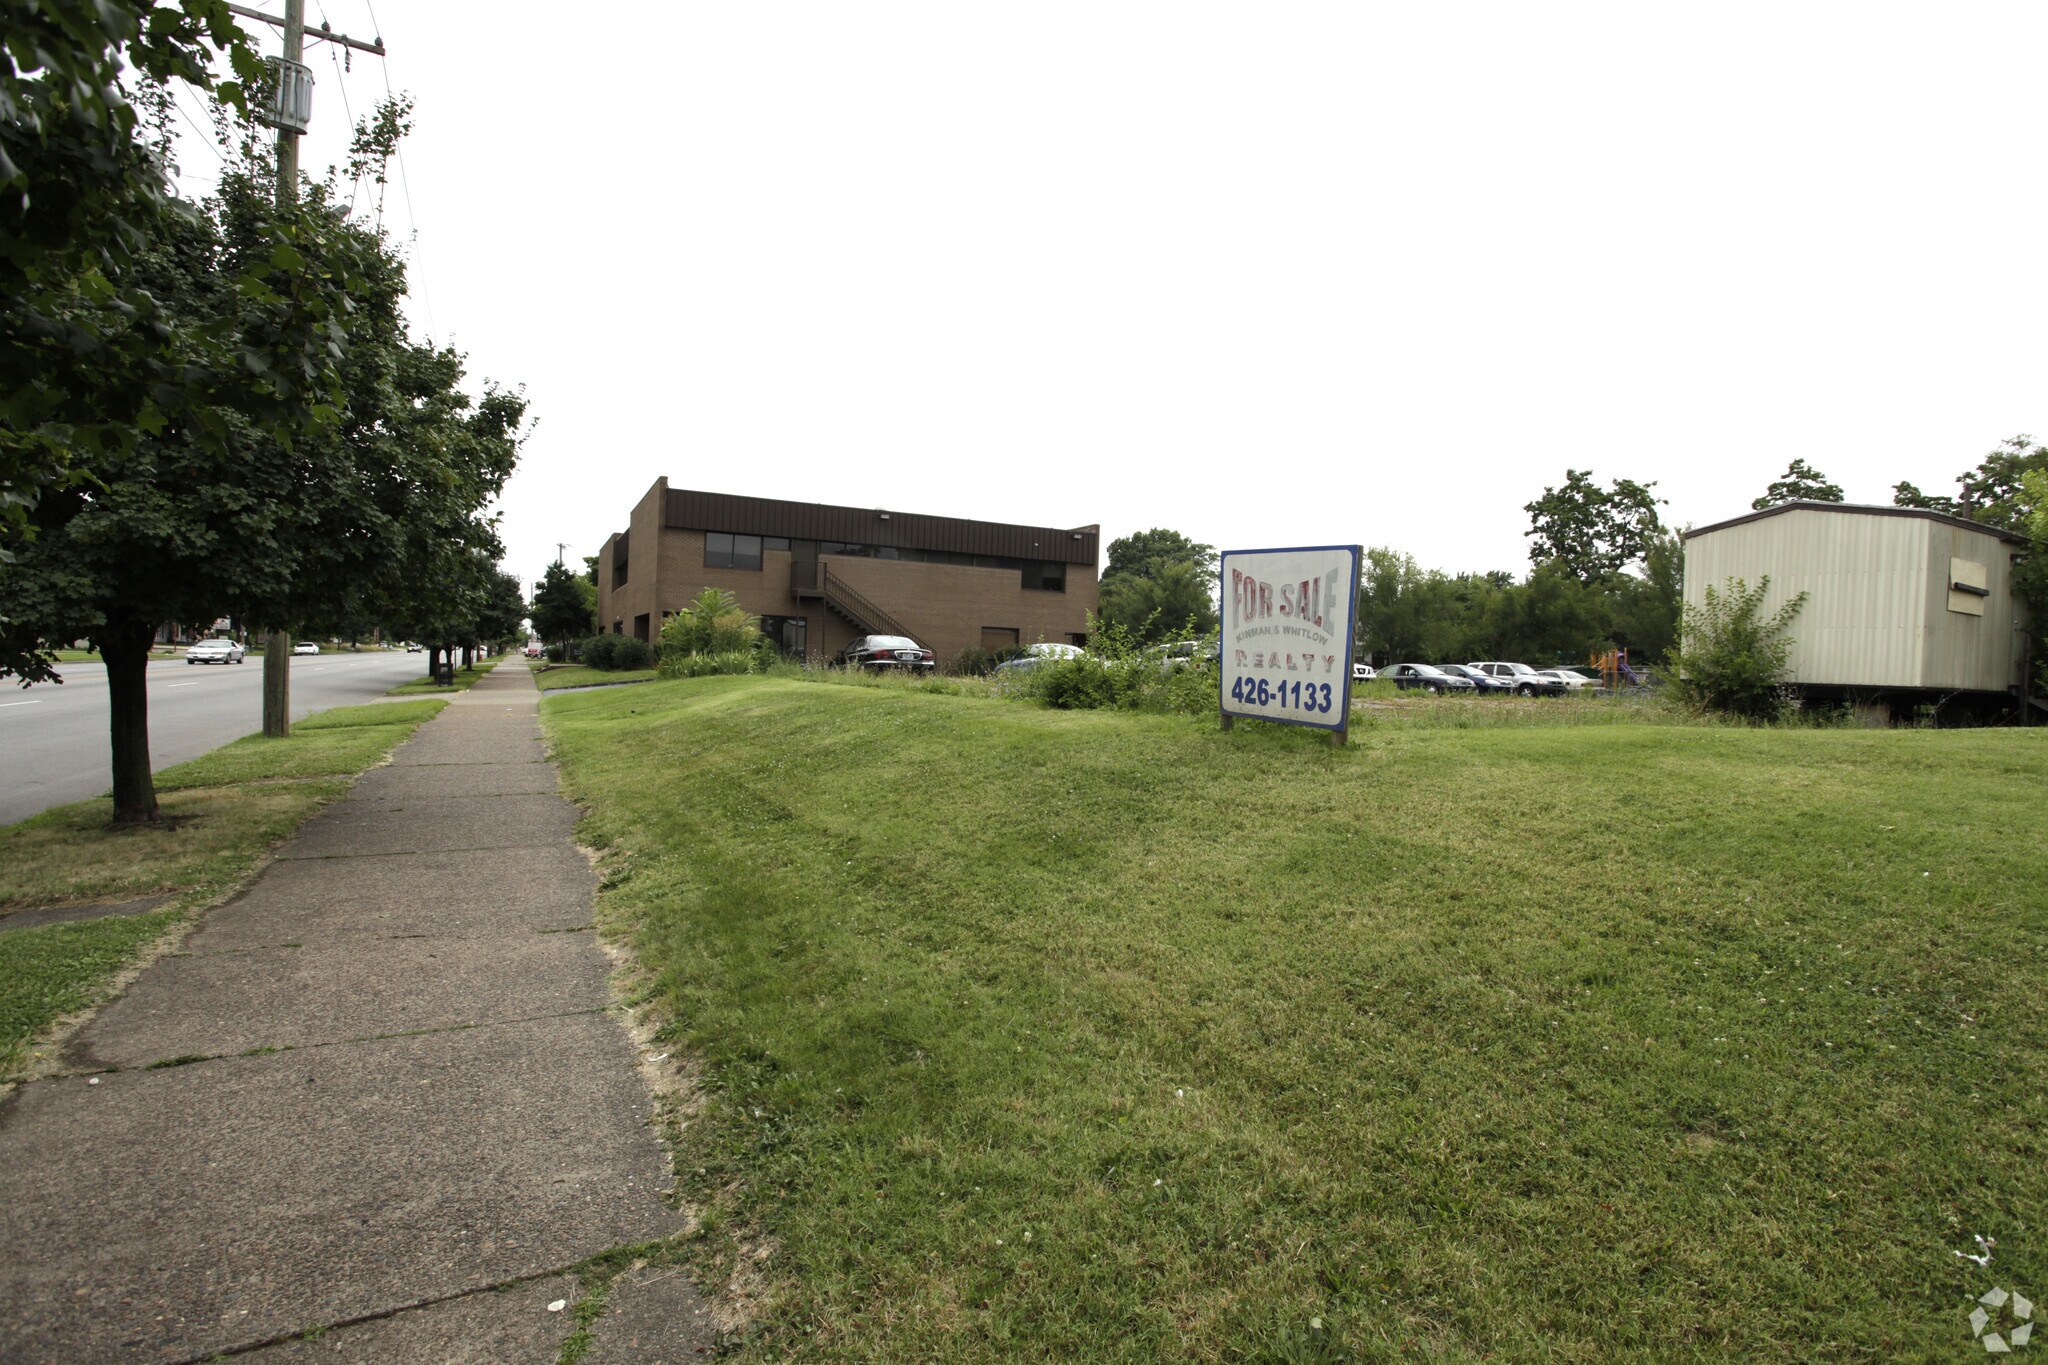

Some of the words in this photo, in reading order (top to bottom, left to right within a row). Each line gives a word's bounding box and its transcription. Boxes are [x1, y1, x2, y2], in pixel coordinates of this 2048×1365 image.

[1232, 568, 1273, 630] FOR
[1279, 567, 1338, 637] SALE
[1235, 626, 1271, 643] KINMAN
[1282, 625, 1329, 646] WHITLOW
[1235, 649, 1336, 673] REALTY
[1231, 676, 1332, 713] 426-1133
